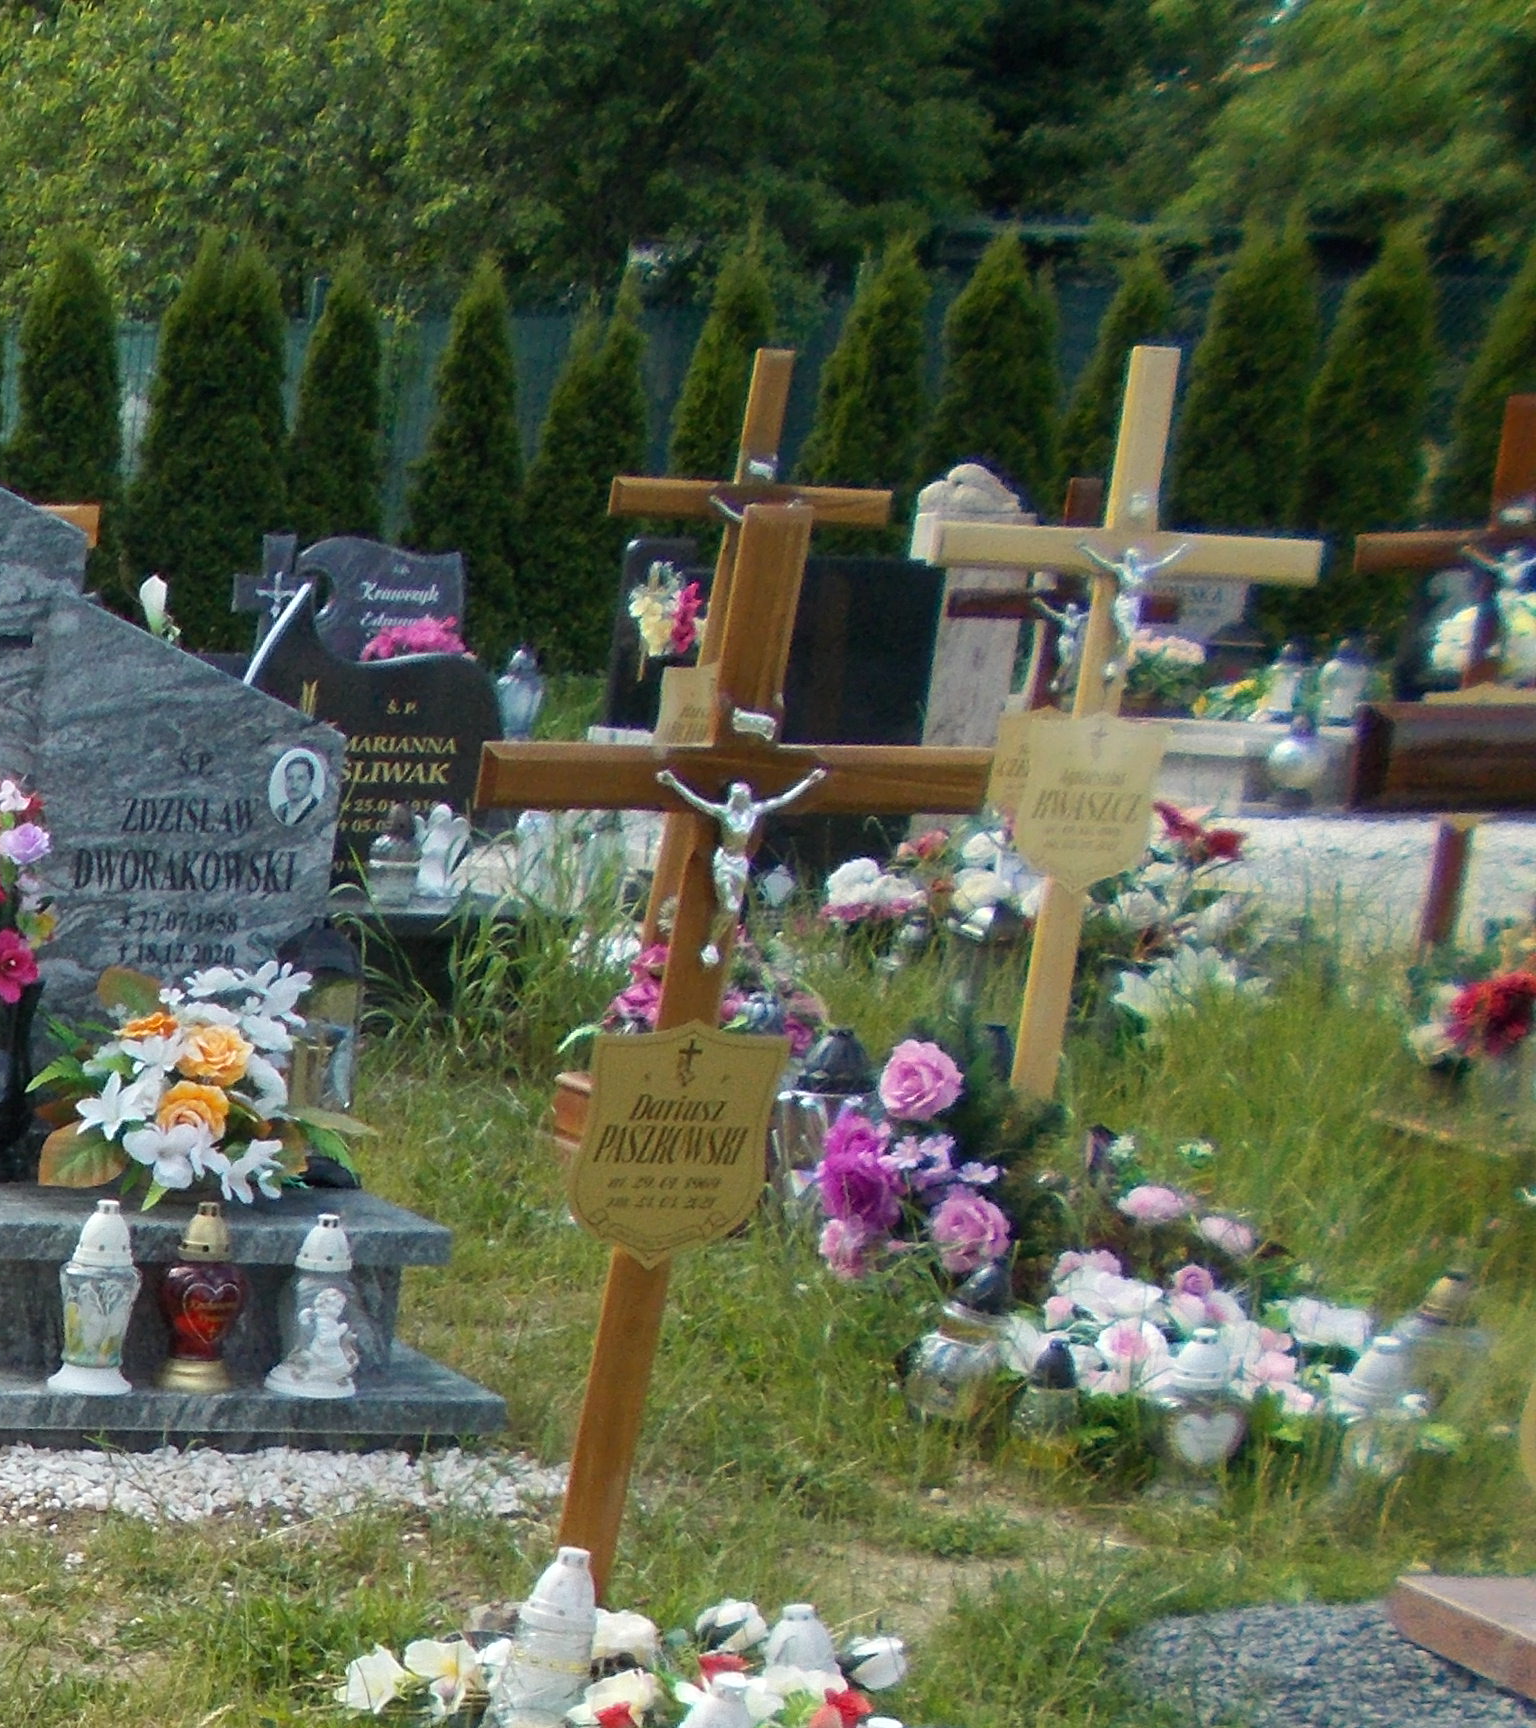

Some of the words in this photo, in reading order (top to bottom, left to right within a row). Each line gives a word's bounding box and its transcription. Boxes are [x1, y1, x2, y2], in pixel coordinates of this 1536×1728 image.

[345, 735, 457, 754] MARIANNA
[341, 759, 452, 785] ŚLIWAK
[121, 798, 258, 834] ZDZISŁAW
[72, 848, 297, 894] DWORAKOWSKI
[628, 1093, 728, 1122] Dariusz
[592, 1124, 749, 1166] PASZKOWSKI
